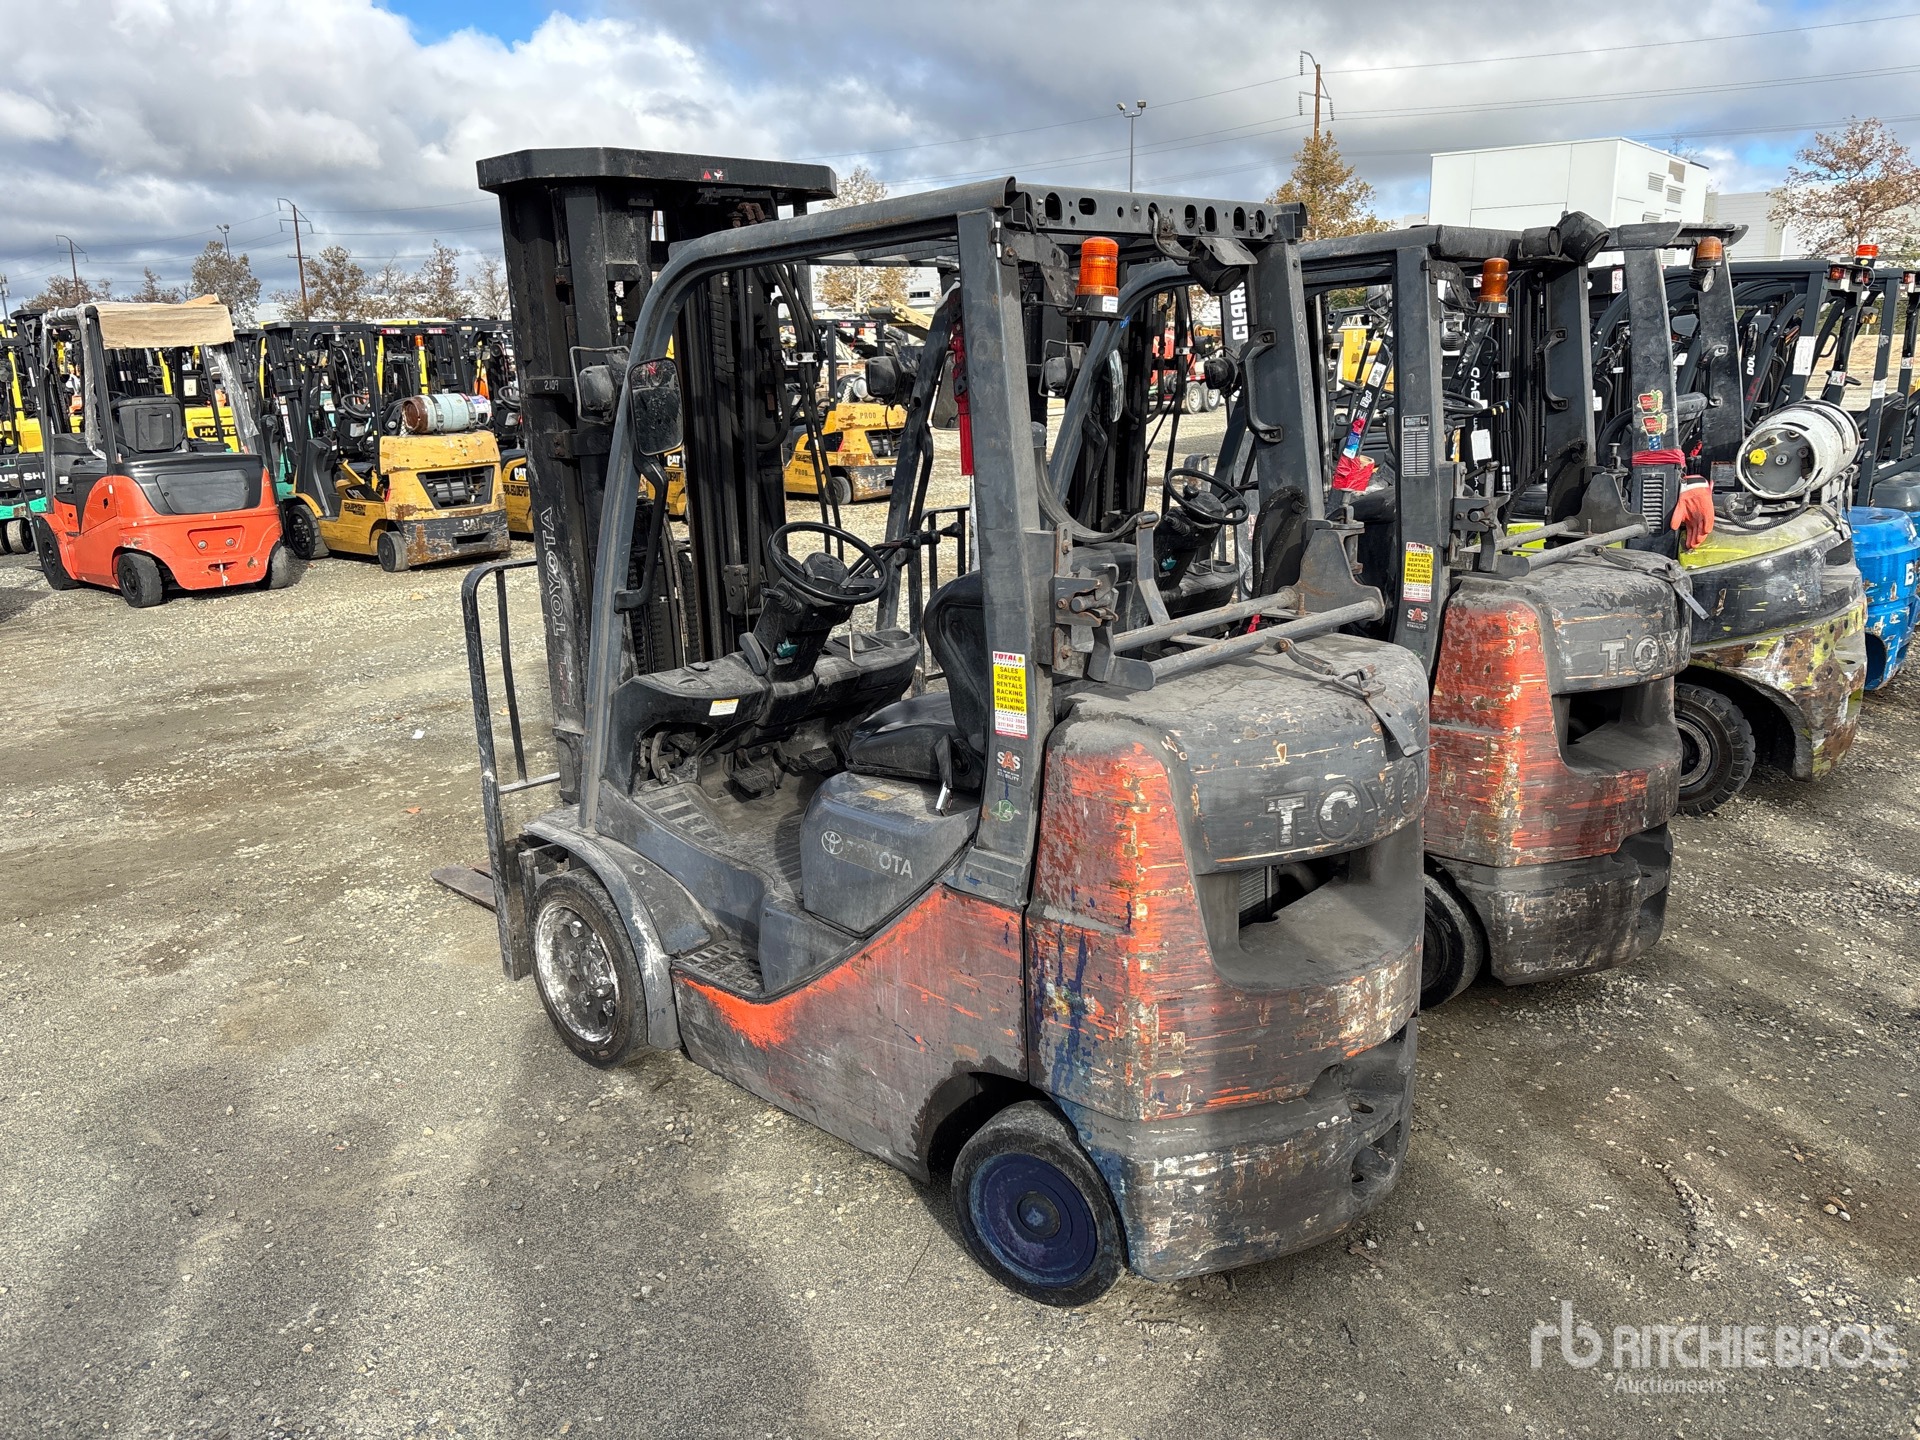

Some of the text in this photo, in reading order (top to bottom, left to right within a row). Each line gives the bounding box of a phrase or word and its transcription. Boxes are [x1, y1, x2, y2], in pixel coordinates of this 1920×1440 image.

[1470, 366, 1480, 400] BYD
[199, 426, 238, 437] HYTE
[667, 455, 681, 467] CAT
[513, 466, 527, 481] CAT
[540, 506, 567, 637] TOYOTA
[1407, 607, 1428, 622] SAS
[993, 653, 1017, 661] TOTAL
[999, 666, 1019, 675] SALES
[997, 674, 1022, 682] SERVICE
[996, 681, 1023, 690] RENTALS
[996, 688, 1023, 697] RACKING
[996, 695, 1025, 704] SHELVING
[996, 702, 1025, 712] TRAINING
[997, 751, 1020, 771] SAS
